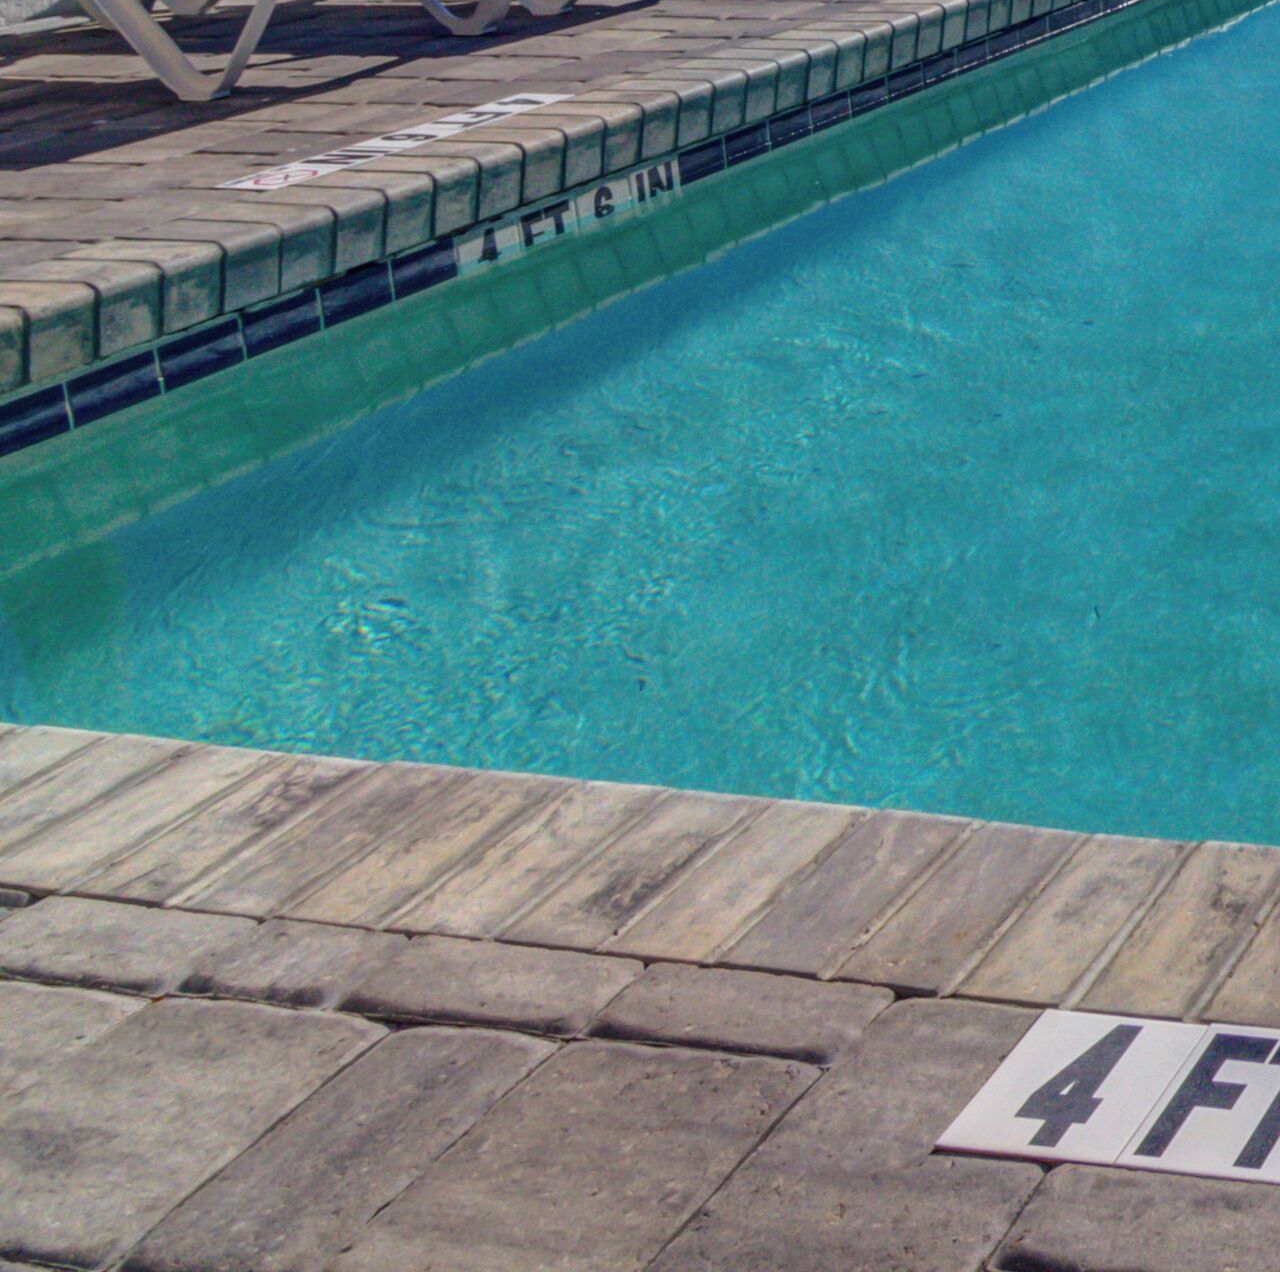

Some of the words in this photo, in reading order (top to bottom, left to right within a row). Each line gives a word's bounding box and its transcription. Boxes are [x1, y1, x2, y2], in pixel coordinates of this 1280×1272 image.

[520, 200, 570, 247] FT
[594, 186, 615, 218] 6
[635, 161, 674, 203] IN
[1014, 1025, 1144, 1147] 4
